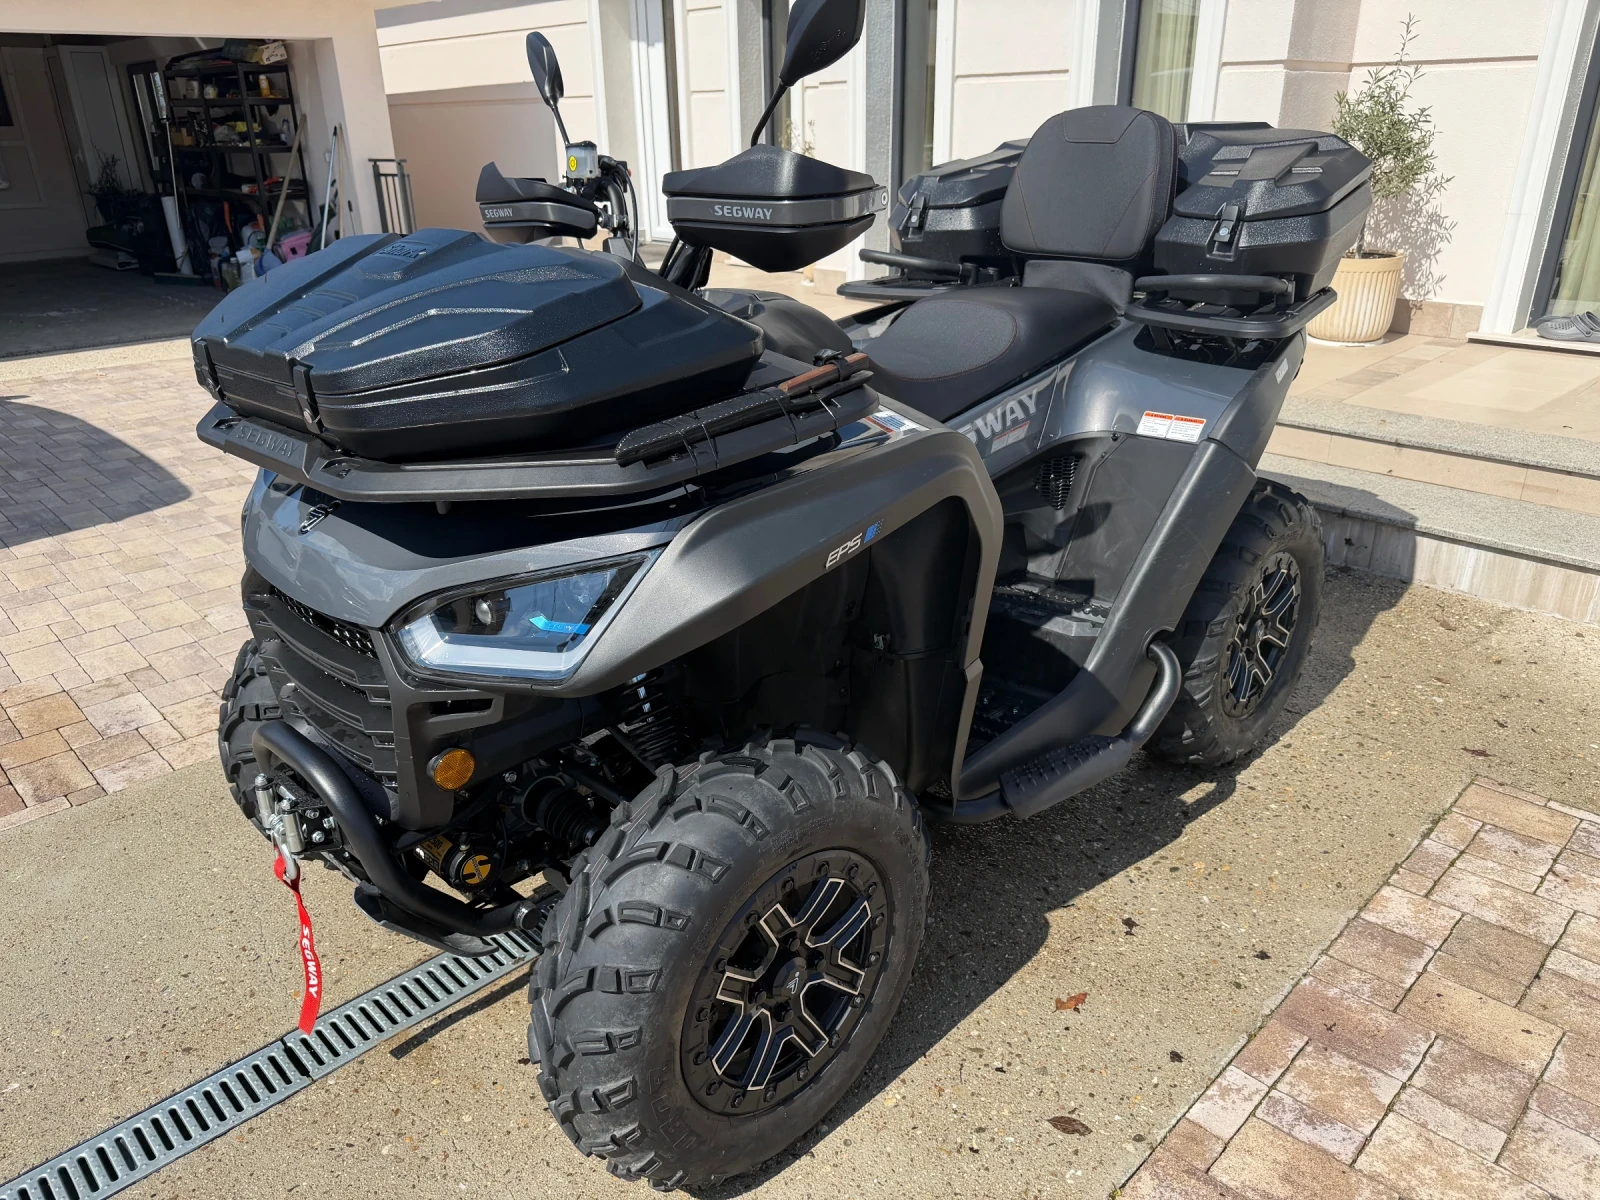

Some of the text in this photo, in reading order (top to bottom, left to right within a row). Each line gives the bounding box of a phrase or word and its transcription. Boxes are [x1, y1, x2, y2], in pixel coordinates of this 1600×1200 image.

[485, 208, 513, 218] SEGWAY
[714, 205, 773, 220] SEGWAY
[237, 425, 300, 458] SEGWAY
[826, 532, 863, 569] EPS
[302, 924, 319, 998] SEGWAY
